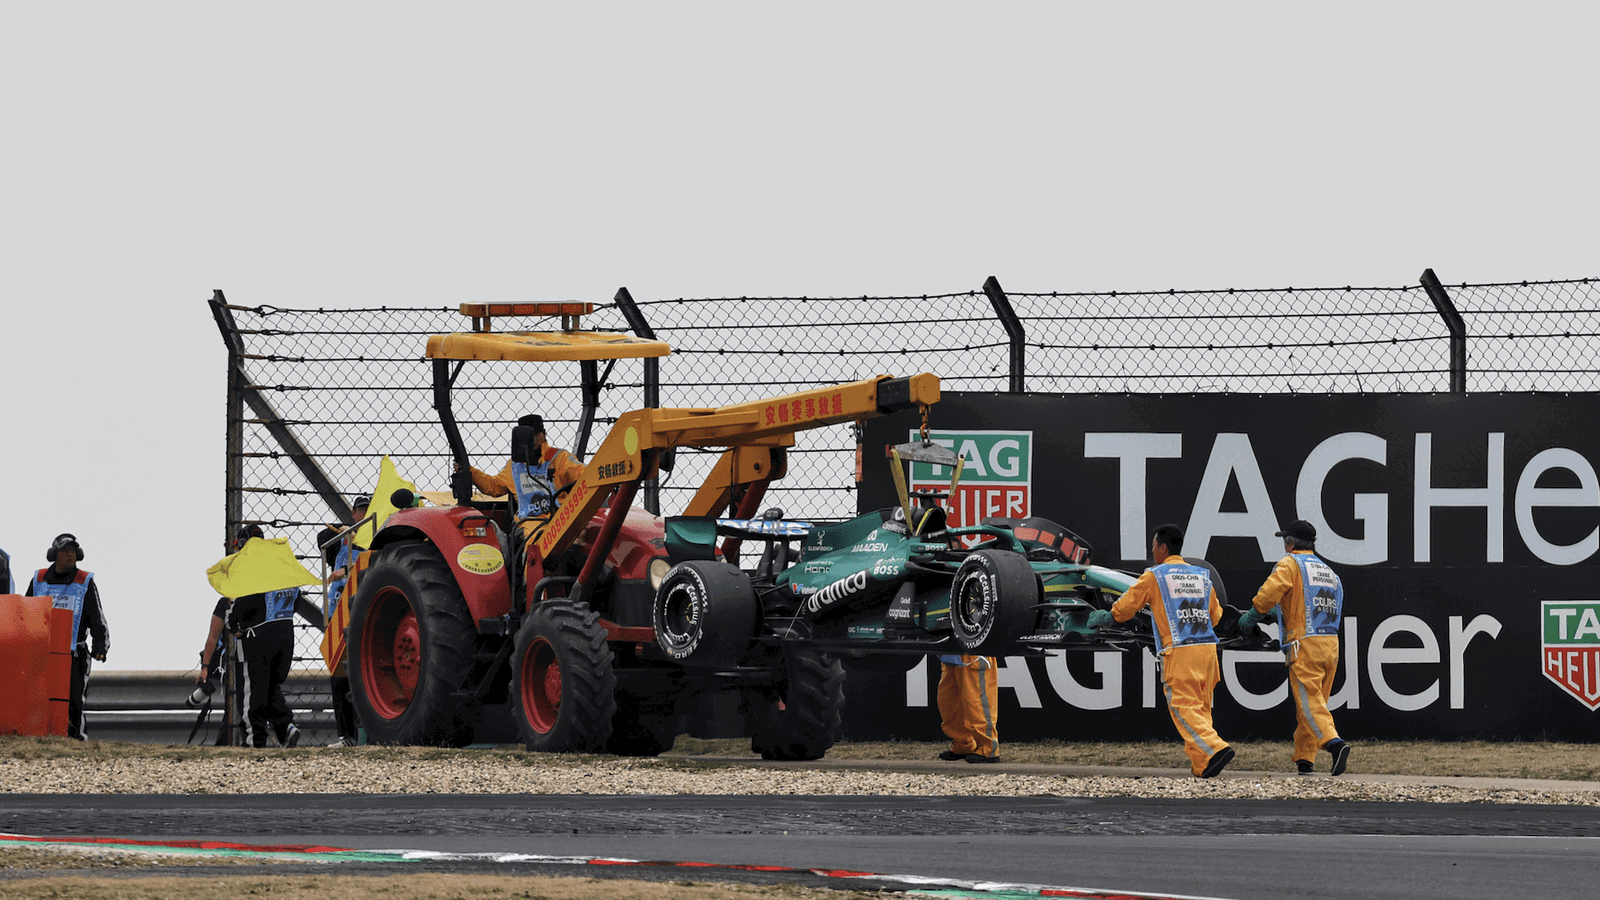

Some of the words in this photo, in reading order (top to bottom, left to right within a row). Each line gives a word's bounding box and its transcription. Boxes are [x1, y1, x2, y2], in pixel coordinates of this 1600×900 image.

[543, 479, 589, 550] 4008895995
[925, 543, 945, 551] BOSS
[873, 566, 899, 576] BOSS
[808, 570, 866, 613] aramco
[1176, 608, 1210, 619] COURSE
[905, 614, 1503, 711] Geuer
